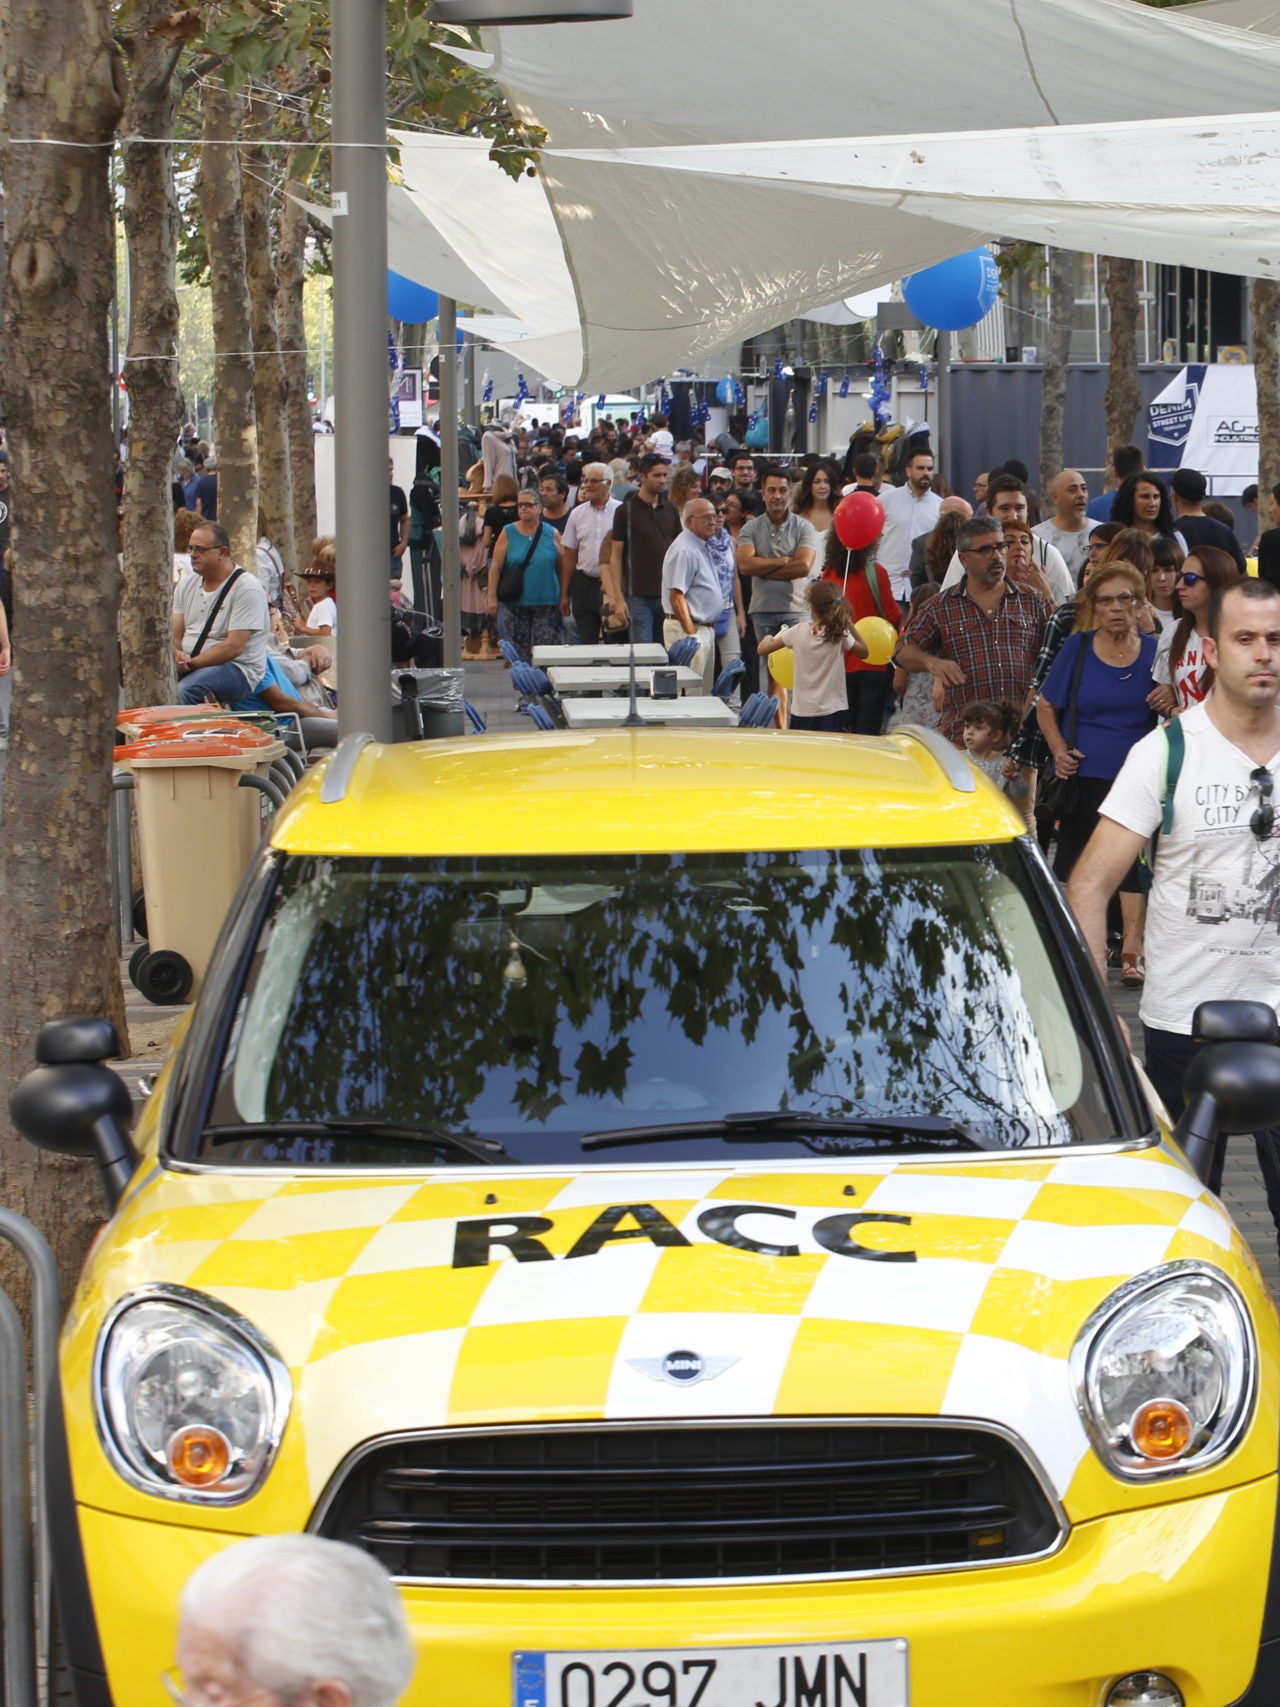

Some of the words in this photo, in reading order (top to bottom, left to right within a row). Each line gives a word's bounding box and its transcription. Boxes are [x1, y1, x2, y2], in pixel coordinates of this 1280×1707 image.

[1150, 397, 1192, 416] DENIM
[1152, 416, 1178, 428] STREET
[1195, 784, 1229, 806] CITY
[1235, 784, 1253, 802] BY
[1204, 805, 1241, 826] CITY
[452, 1203, 917, 1269] RACC
[666, 1359, 702, 1371] MINI
[755, 1653, 867, 1707] JMN
